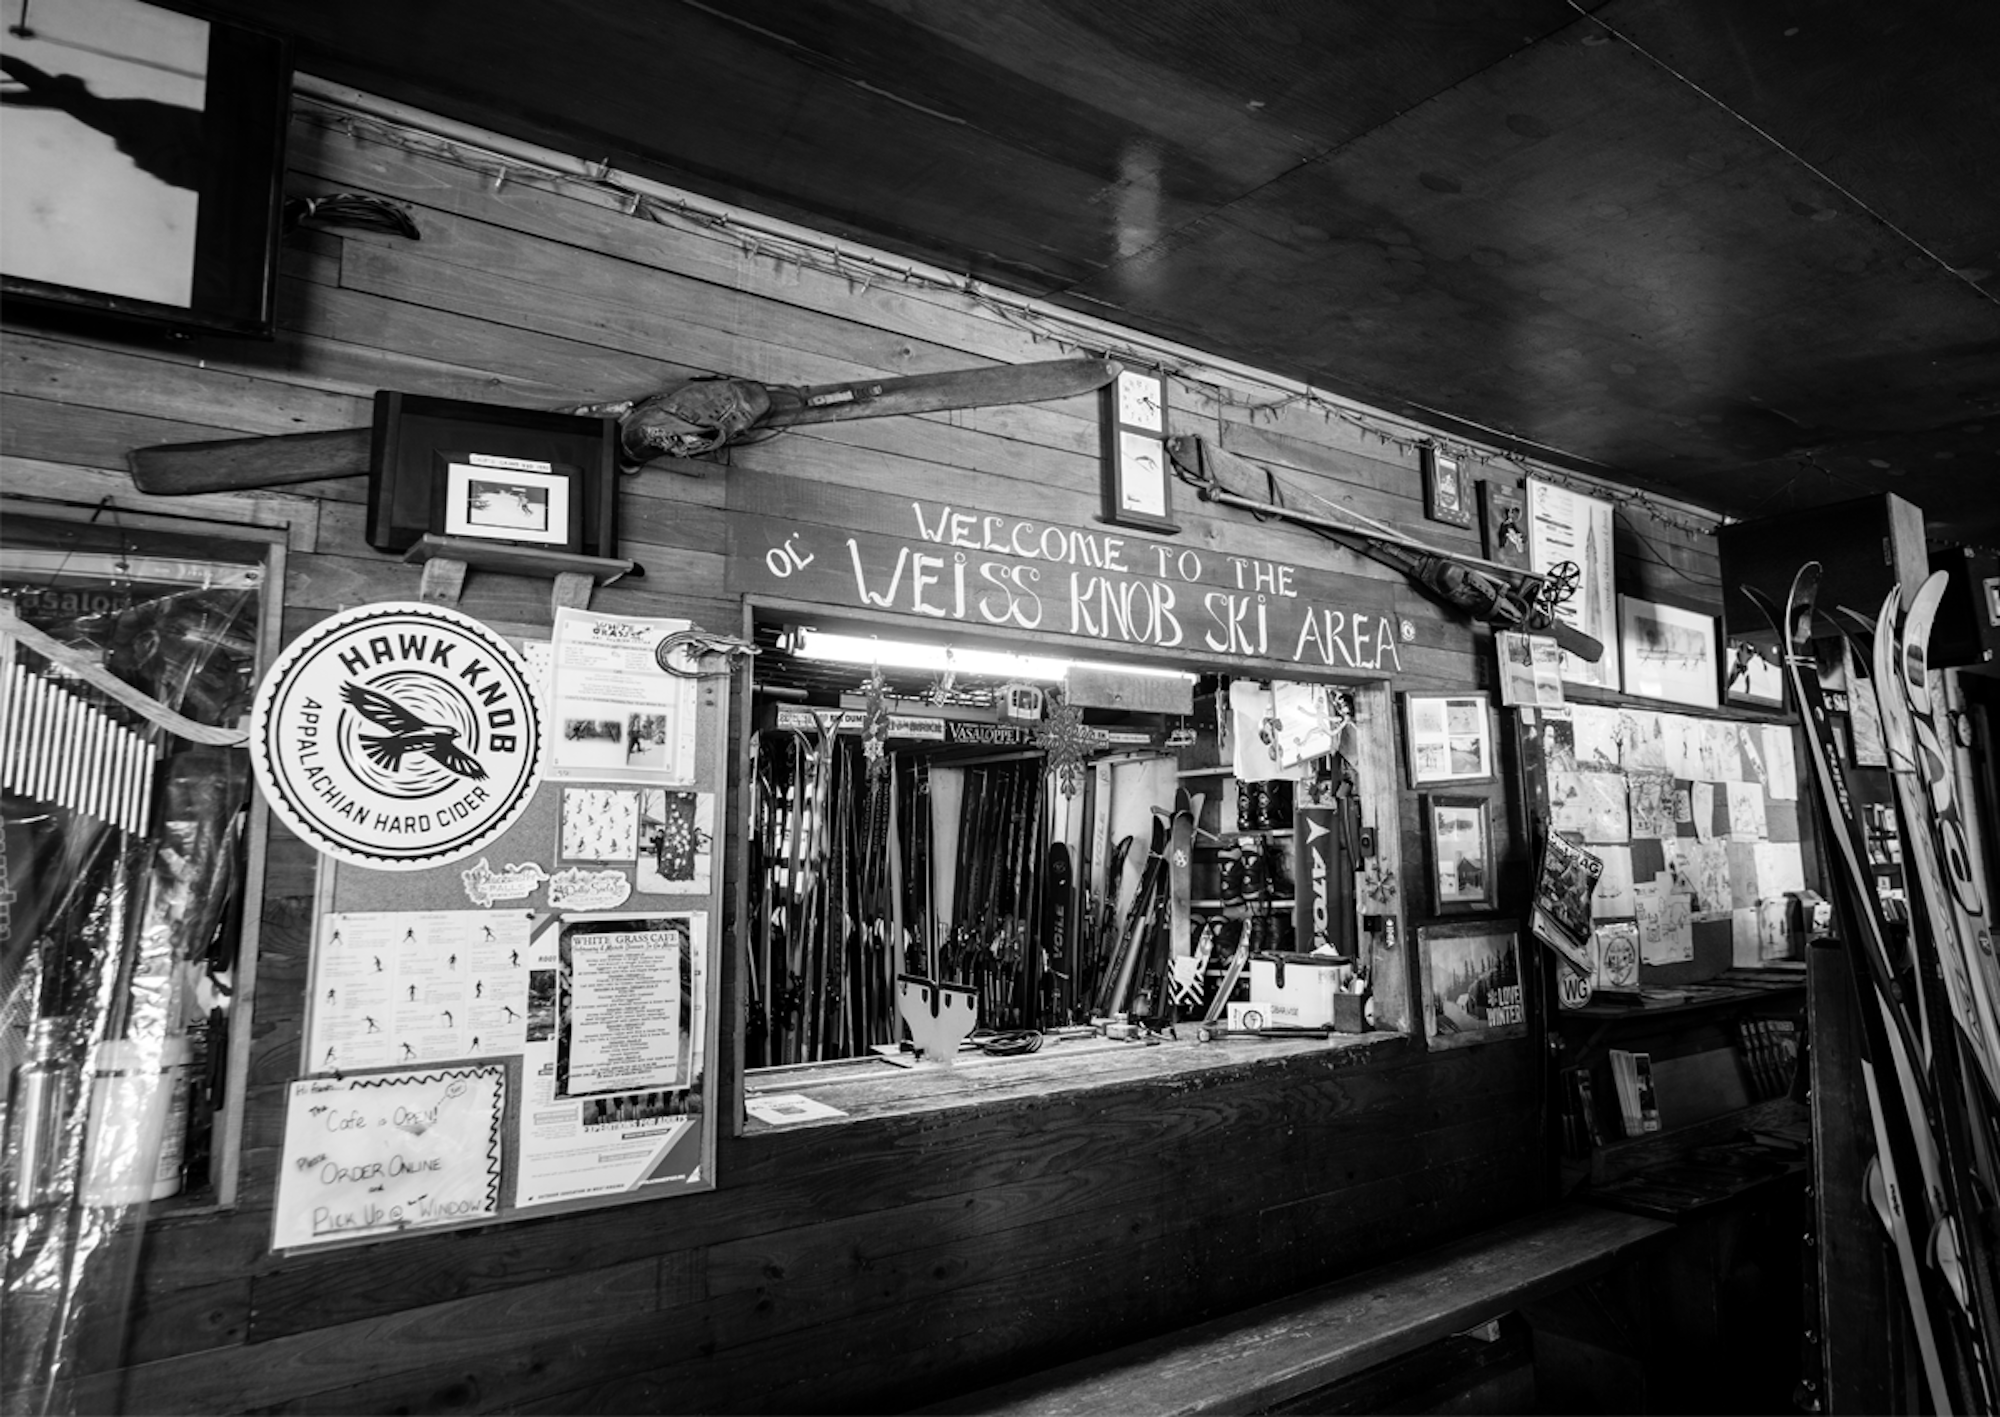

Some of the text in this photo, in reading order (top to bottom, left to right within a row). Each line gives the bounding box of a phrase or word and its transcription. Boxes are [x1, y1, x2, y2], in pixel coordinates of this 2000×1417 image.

[912, 502, 1298, 598] WELCOME TO THE
[846, 538, 1042, 629] WEISS
[1070, 572, 1183, 647] KNOB
[1204, 592, 1268, 656] SKI
[1293, 606, 1401, 671] AREA
[337, 633, 517, 753] HAWK KNOB
[297, 696, 491, 834] APPALACHIAN HARD CIDER
[573, 933, 675, 946] WHITE GRASS CAFE
[1053, 905, 1066, 959] VOILE
[1497, 985, 1520, 1007] LOVE
[1564, 979, 1588, 1001] WG
[1486, 1004, 1523, 1028] WINTER
[326, 1109, 367, 1132] Cafe
[320, 1154, 442, 1184] ORDER ONLINE
[313, 1206, 357, 1231] PICK
[364, 1203, 384, 1226] UP
[390, 1205, 404, 1220] @
[419, 1199, 483, 1218] WINDOW
